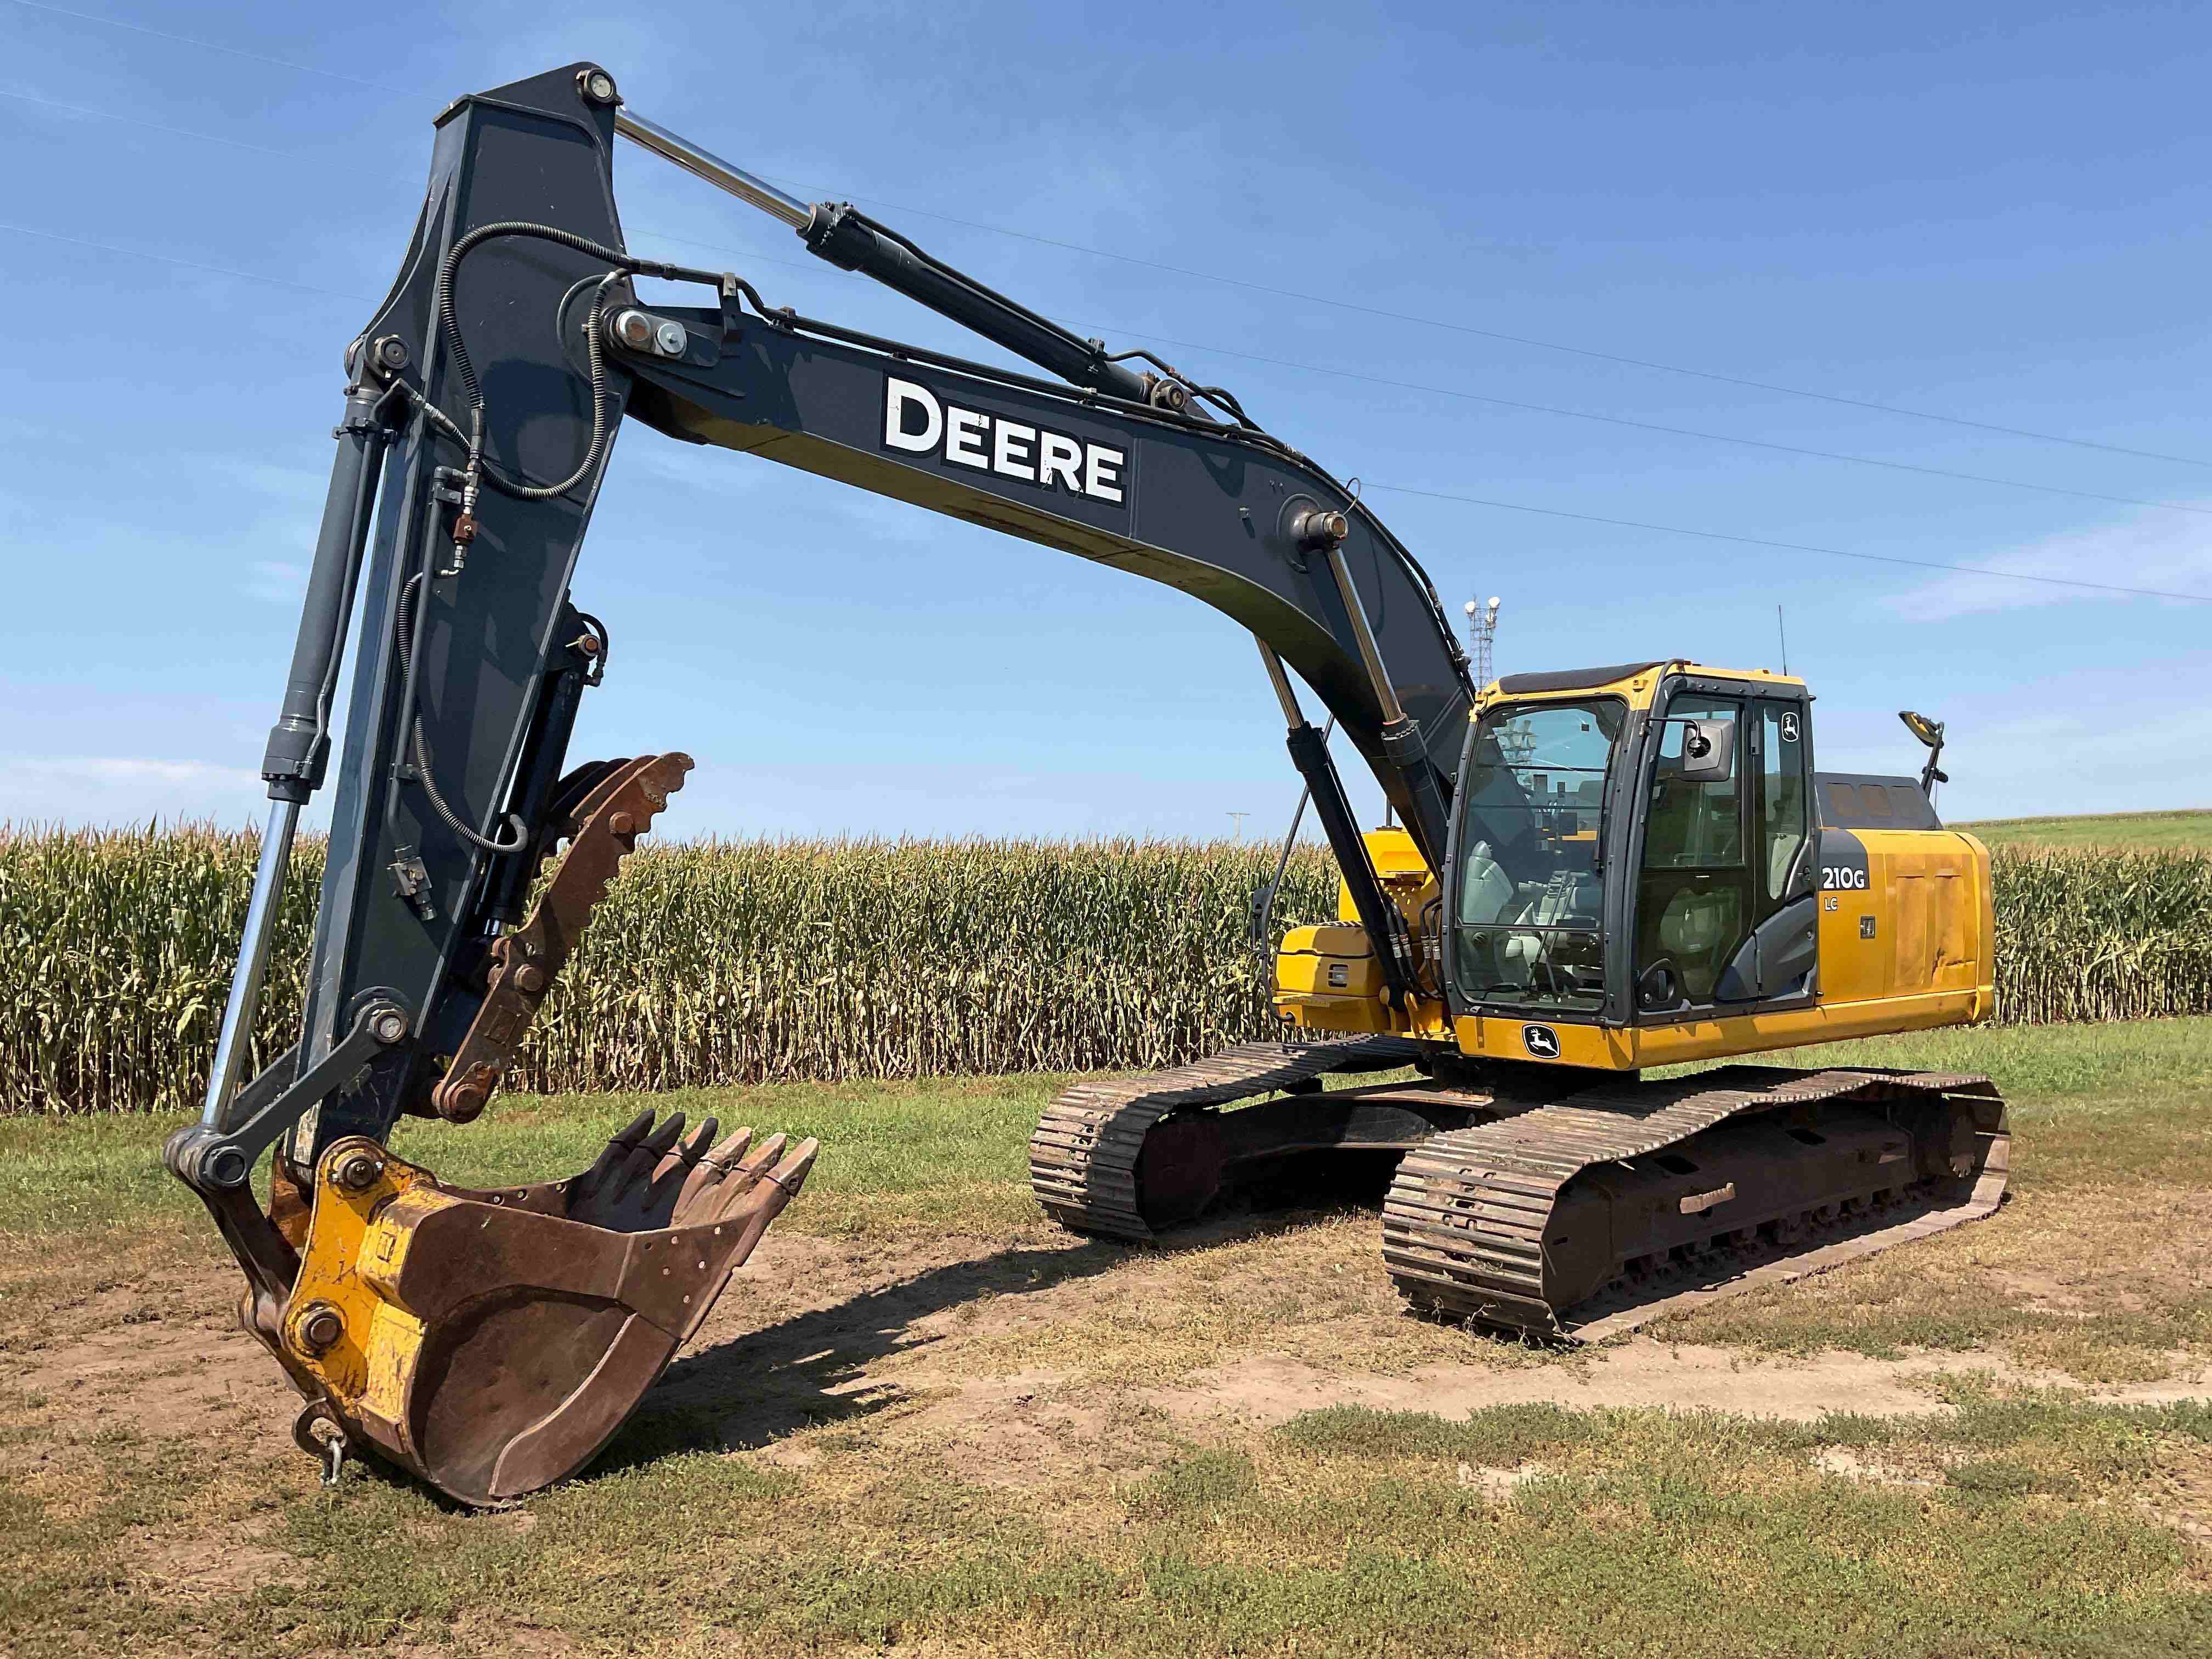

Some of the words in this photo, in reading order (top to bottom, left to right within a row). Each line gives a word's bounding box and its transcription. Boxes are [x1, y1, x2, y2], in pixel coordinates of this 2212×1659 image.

[885, 377, 1124, 503] DEERE
[1822, 867, 1865, 889] 210G
[1824, 898, 1838, 911] LC
